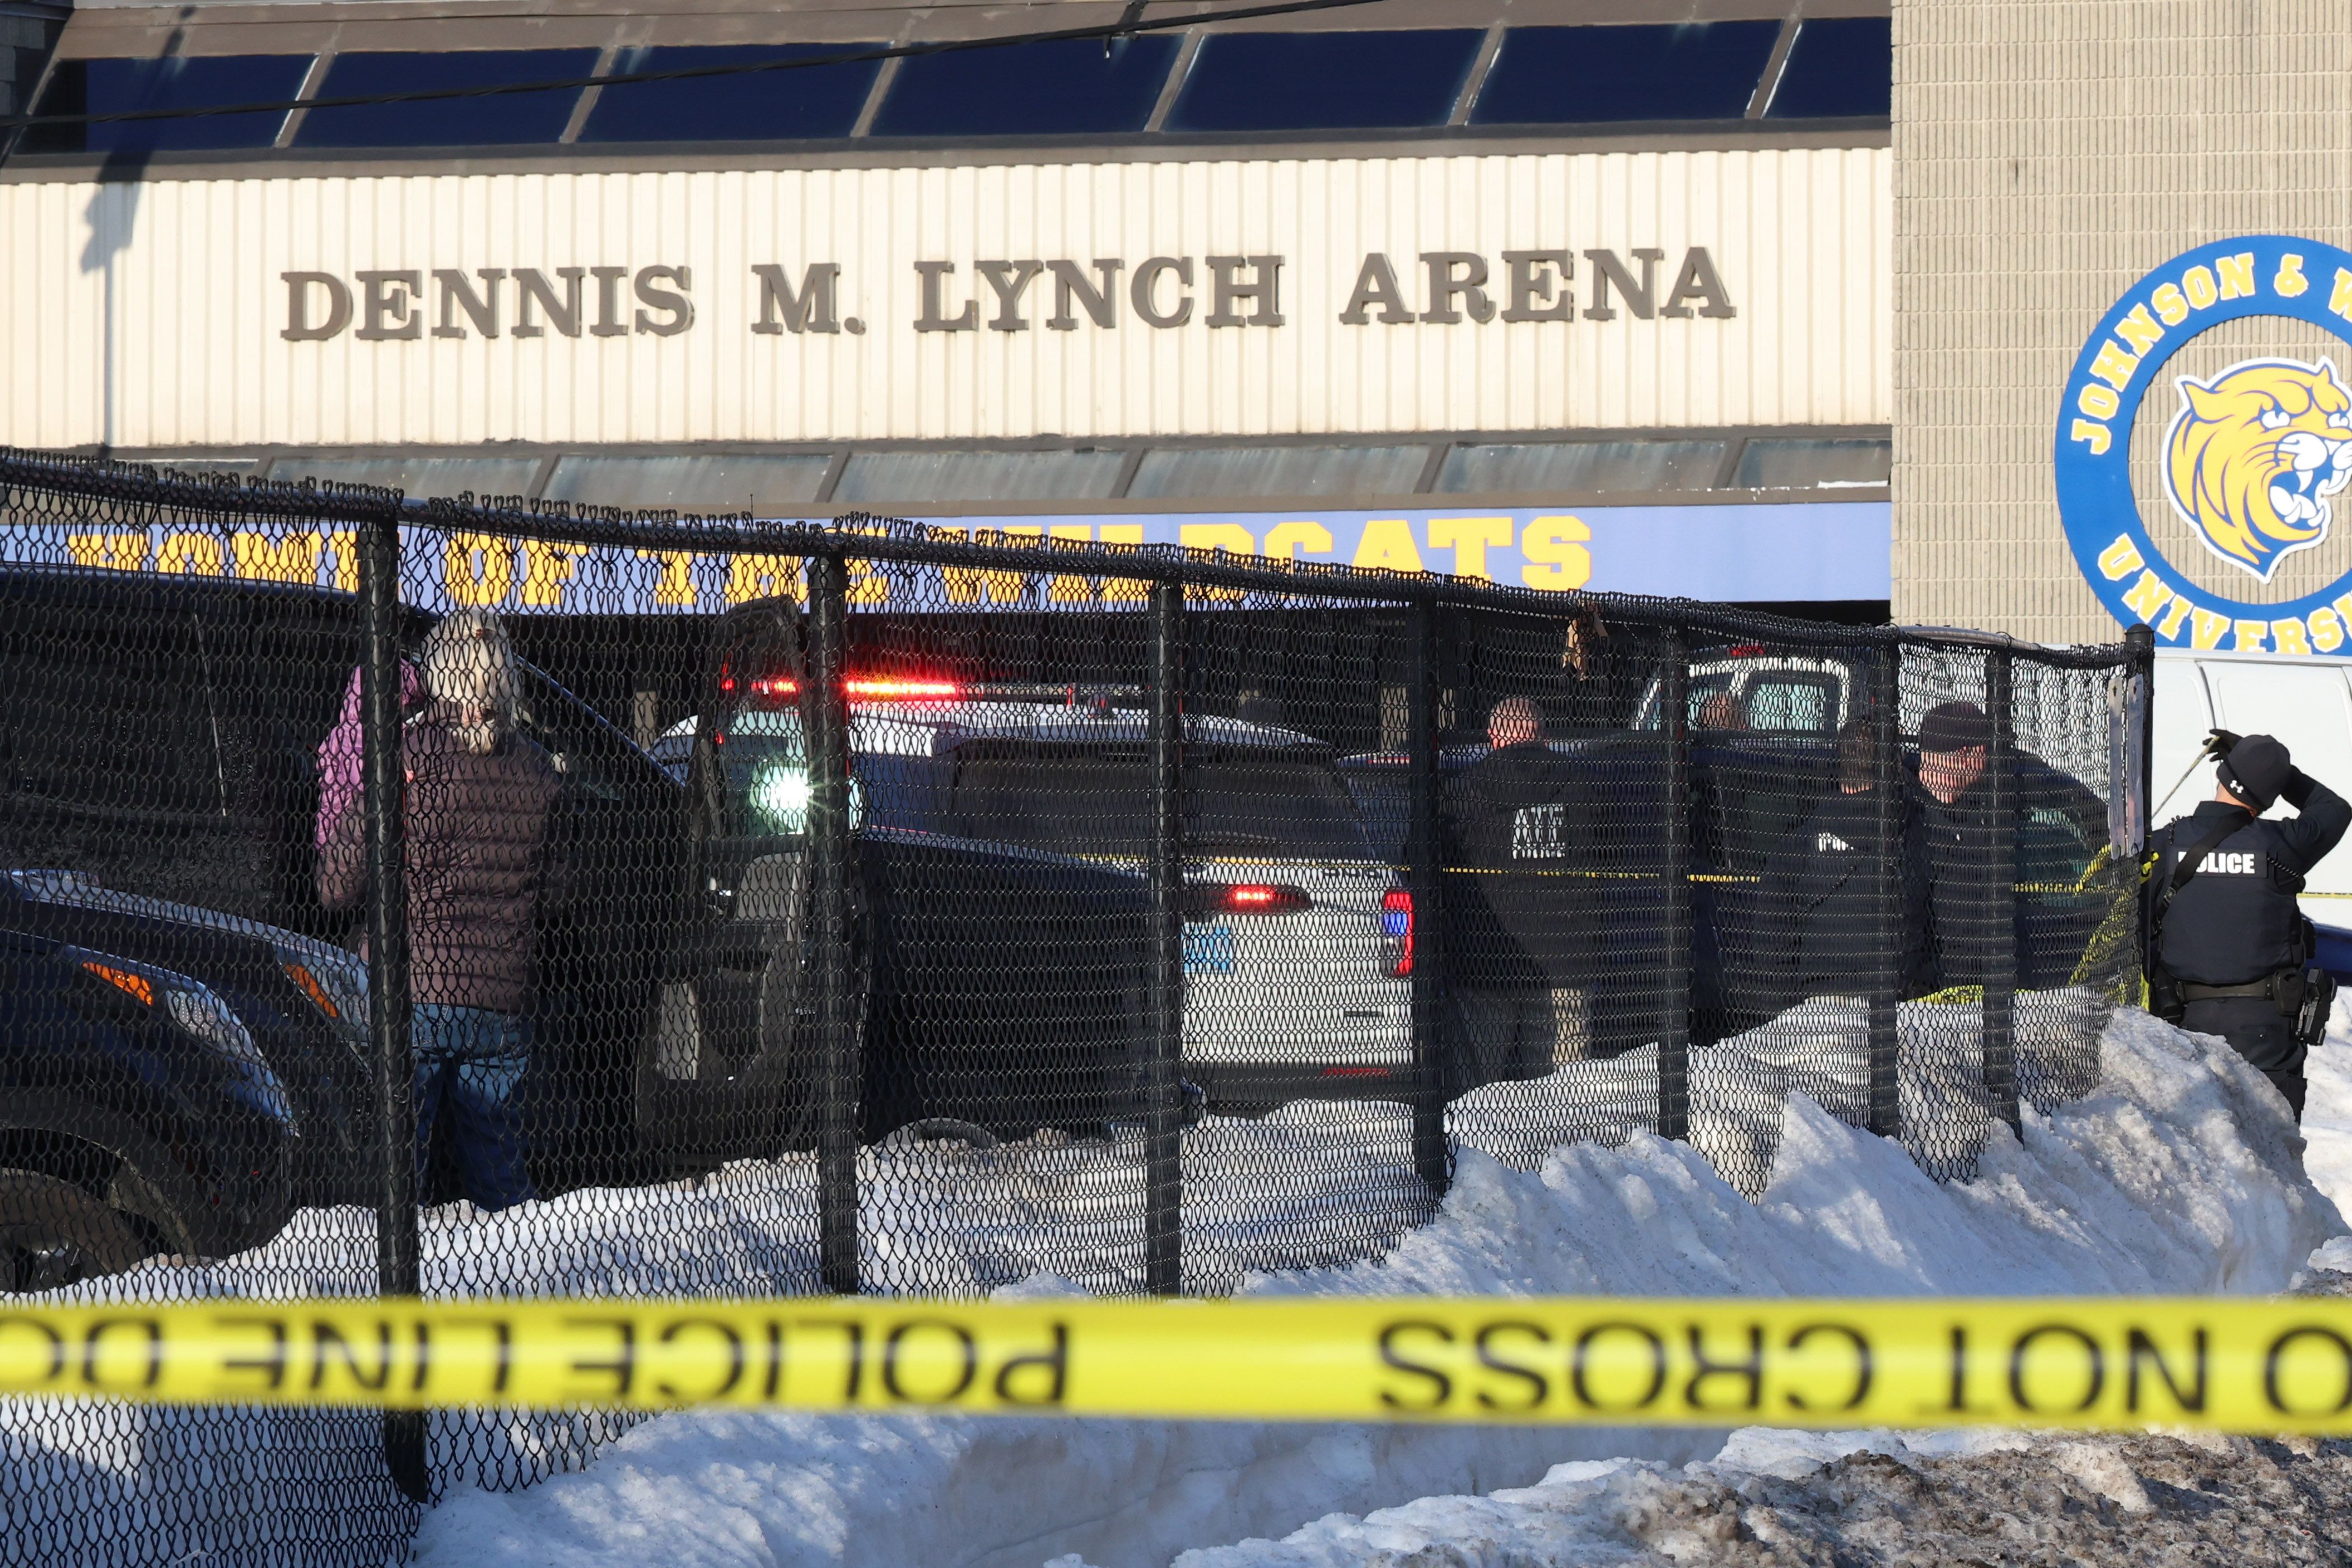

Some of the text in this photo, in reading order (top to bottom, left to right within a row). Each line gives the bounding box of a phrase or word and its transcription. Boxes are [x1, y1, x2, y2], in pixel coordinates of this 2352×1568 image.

[280, 247, 1737, 342] DENNIS M. LYNCH ARENA
[2070, 252, 2256, 455] JOHNSON
[2274, 254, 2309, 298] &
[2098, 533, 2352, 655] UNIVERSI
[216, 1317, 511, 1393] LINE
[564, 1317, 1068, 1407] POLICE
[1376, 1320, 1874, 1412] CROSS
[1914, 1324, 2209, 1415] NOT
